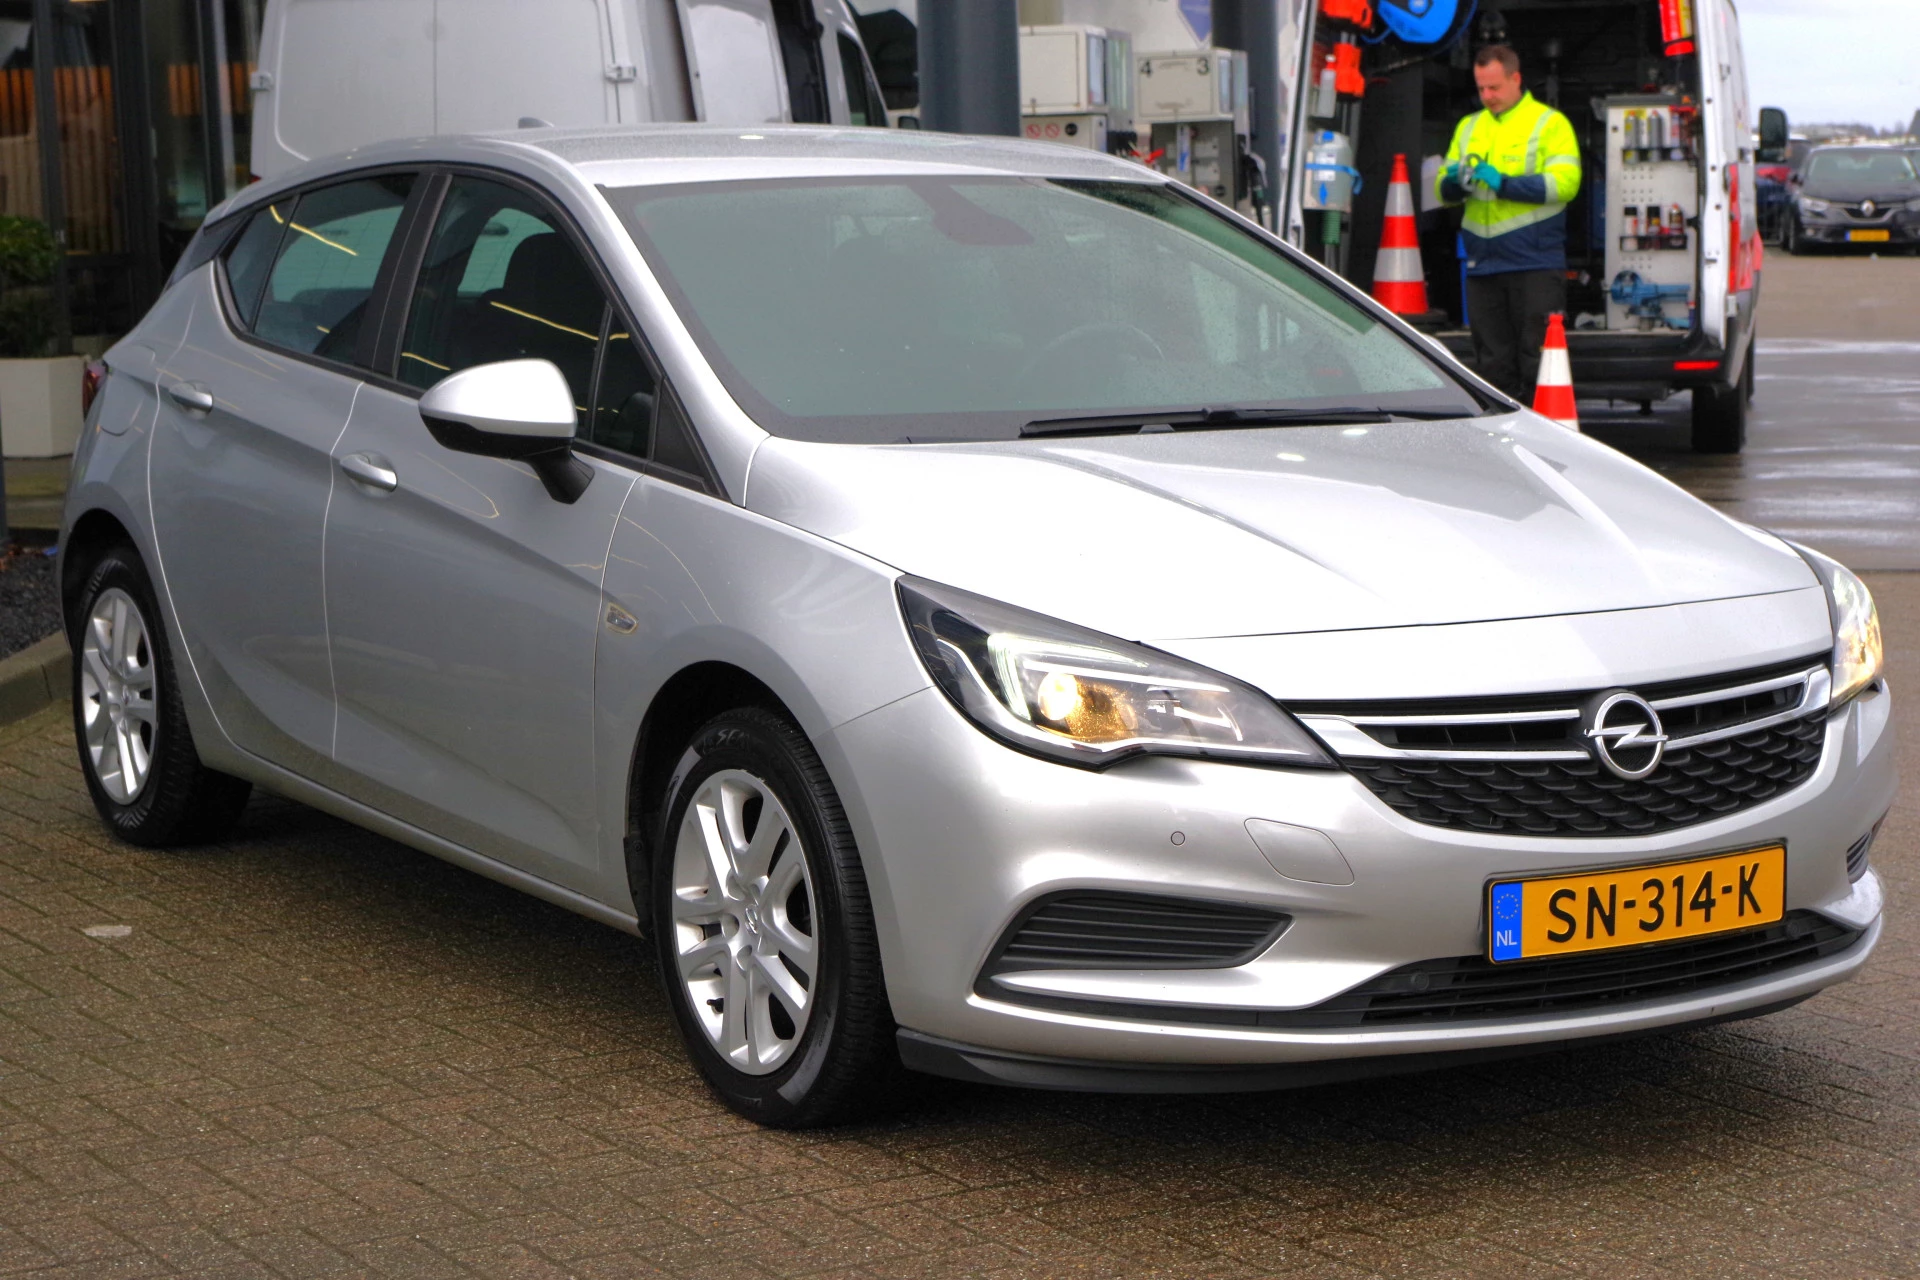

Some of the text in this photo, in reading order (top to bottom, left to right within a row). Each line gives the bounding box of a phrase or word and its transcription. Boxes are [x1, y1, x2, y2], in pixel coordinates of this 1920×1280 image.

[1140, 60, 1152, 77] 4
[1197, 57, 1210, 75] 3
[1547, 862, 1762, 944] SN-314-K
[1496, 929, 1518, 947] NL
